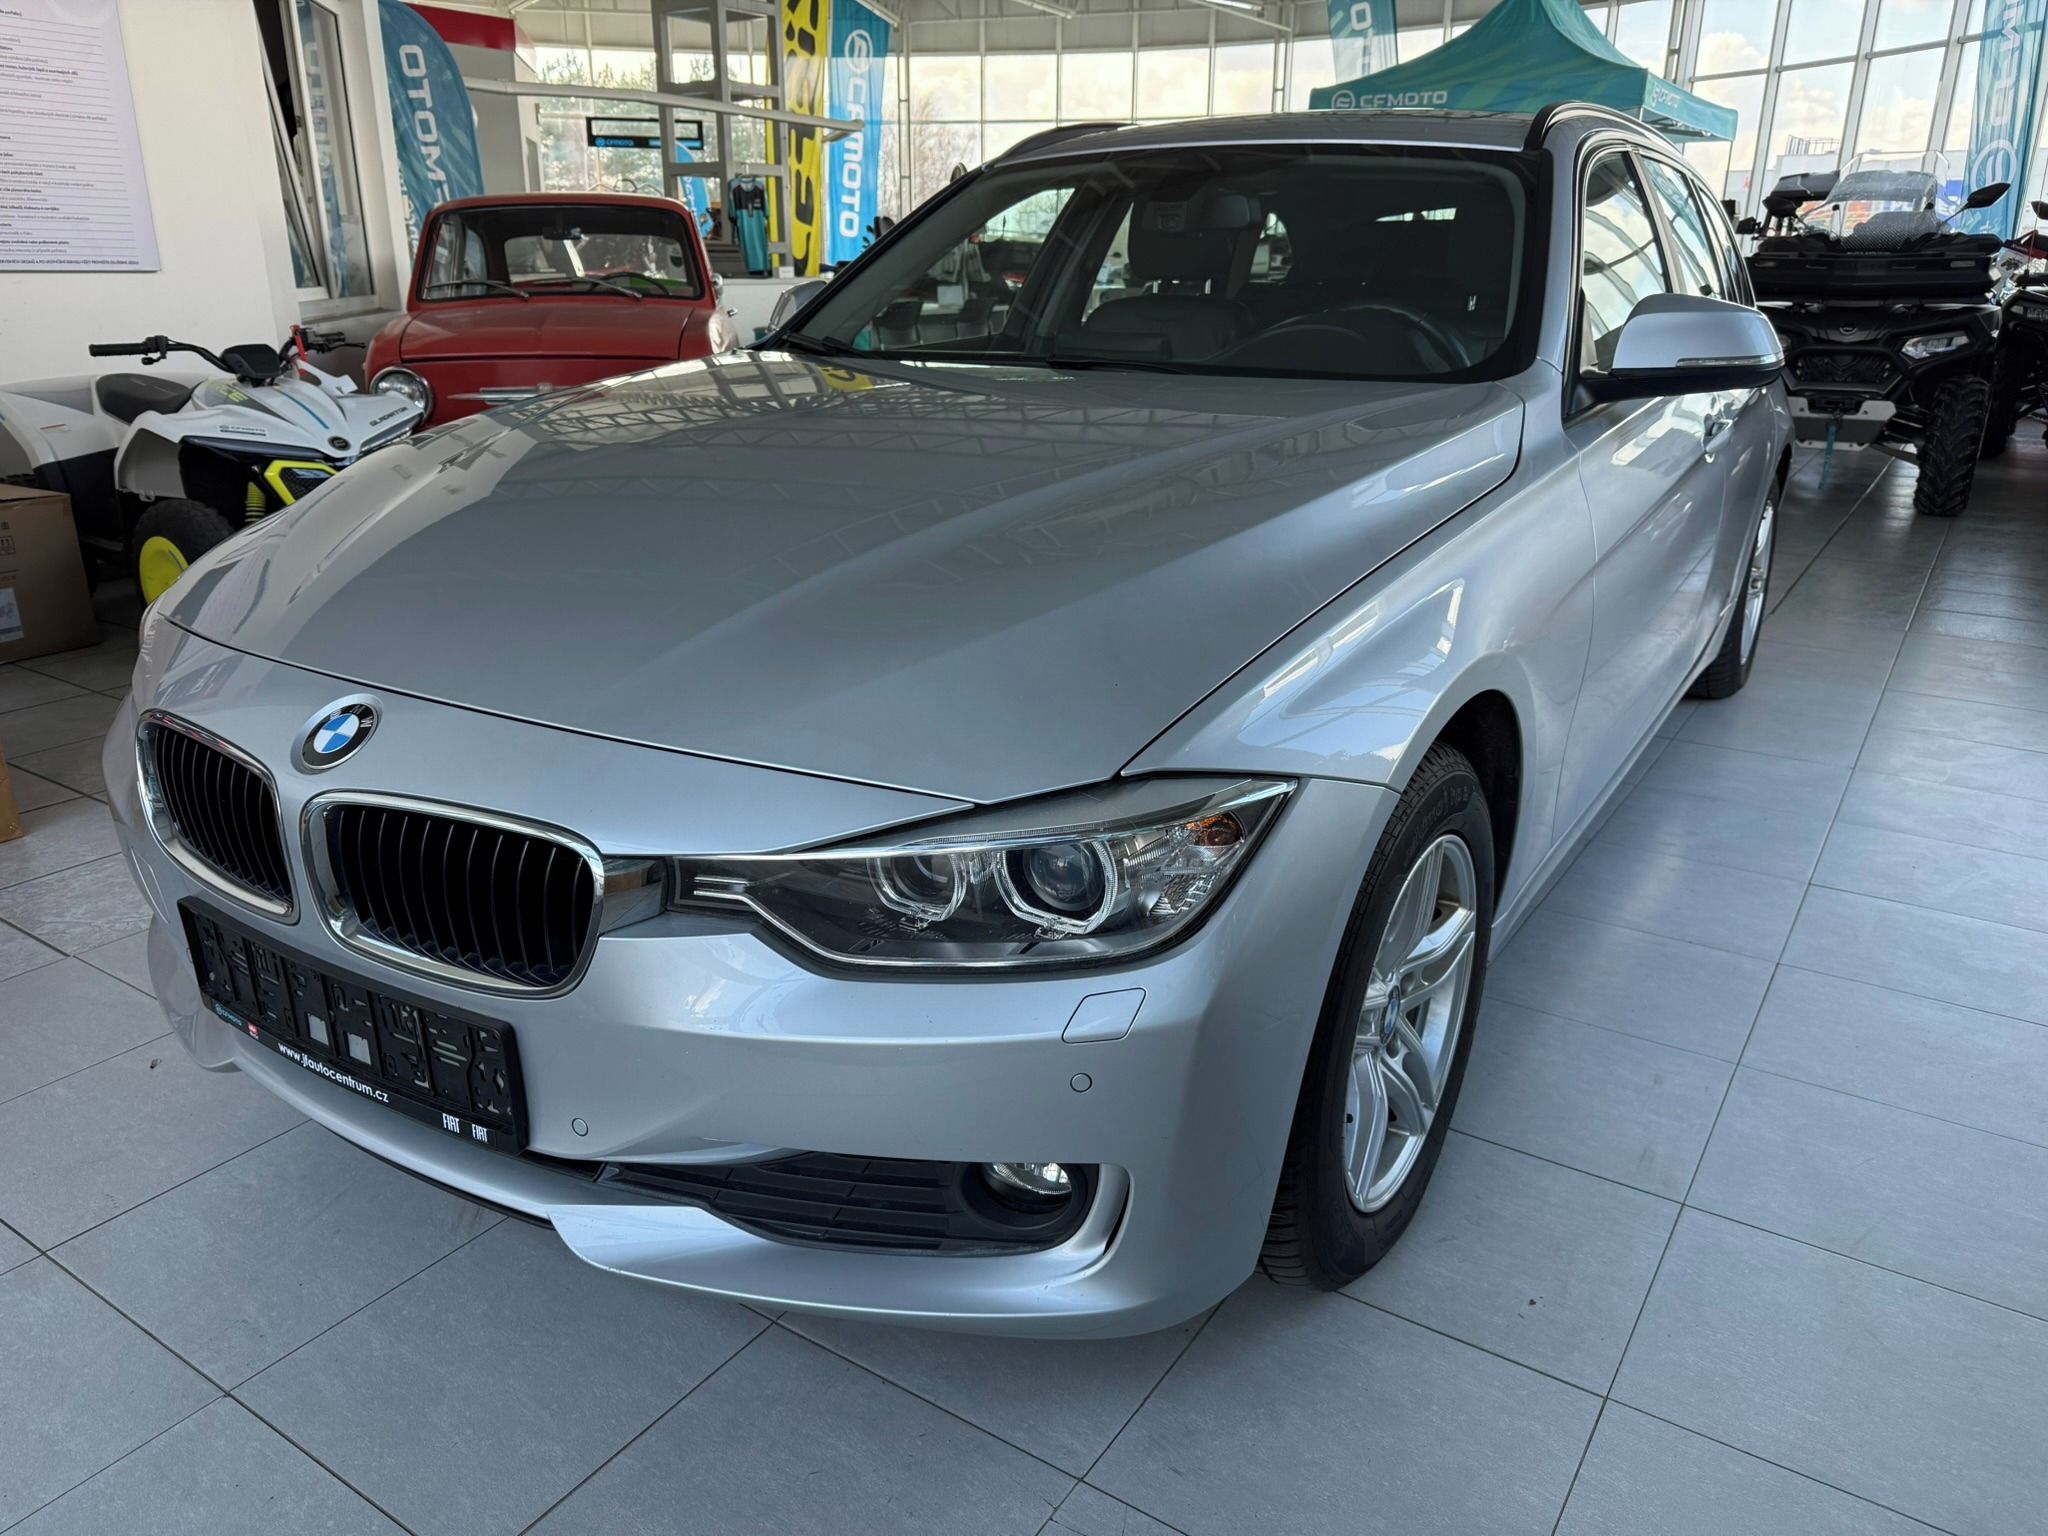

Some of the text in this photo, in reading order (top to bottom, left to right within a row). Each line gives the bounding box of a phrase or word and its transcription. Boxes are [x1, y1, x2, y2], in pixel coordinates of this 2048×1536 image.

[1360, 90, 1448, 108] CFMOTO
[442, 1112, 488, 1143] FIAT FIAT
